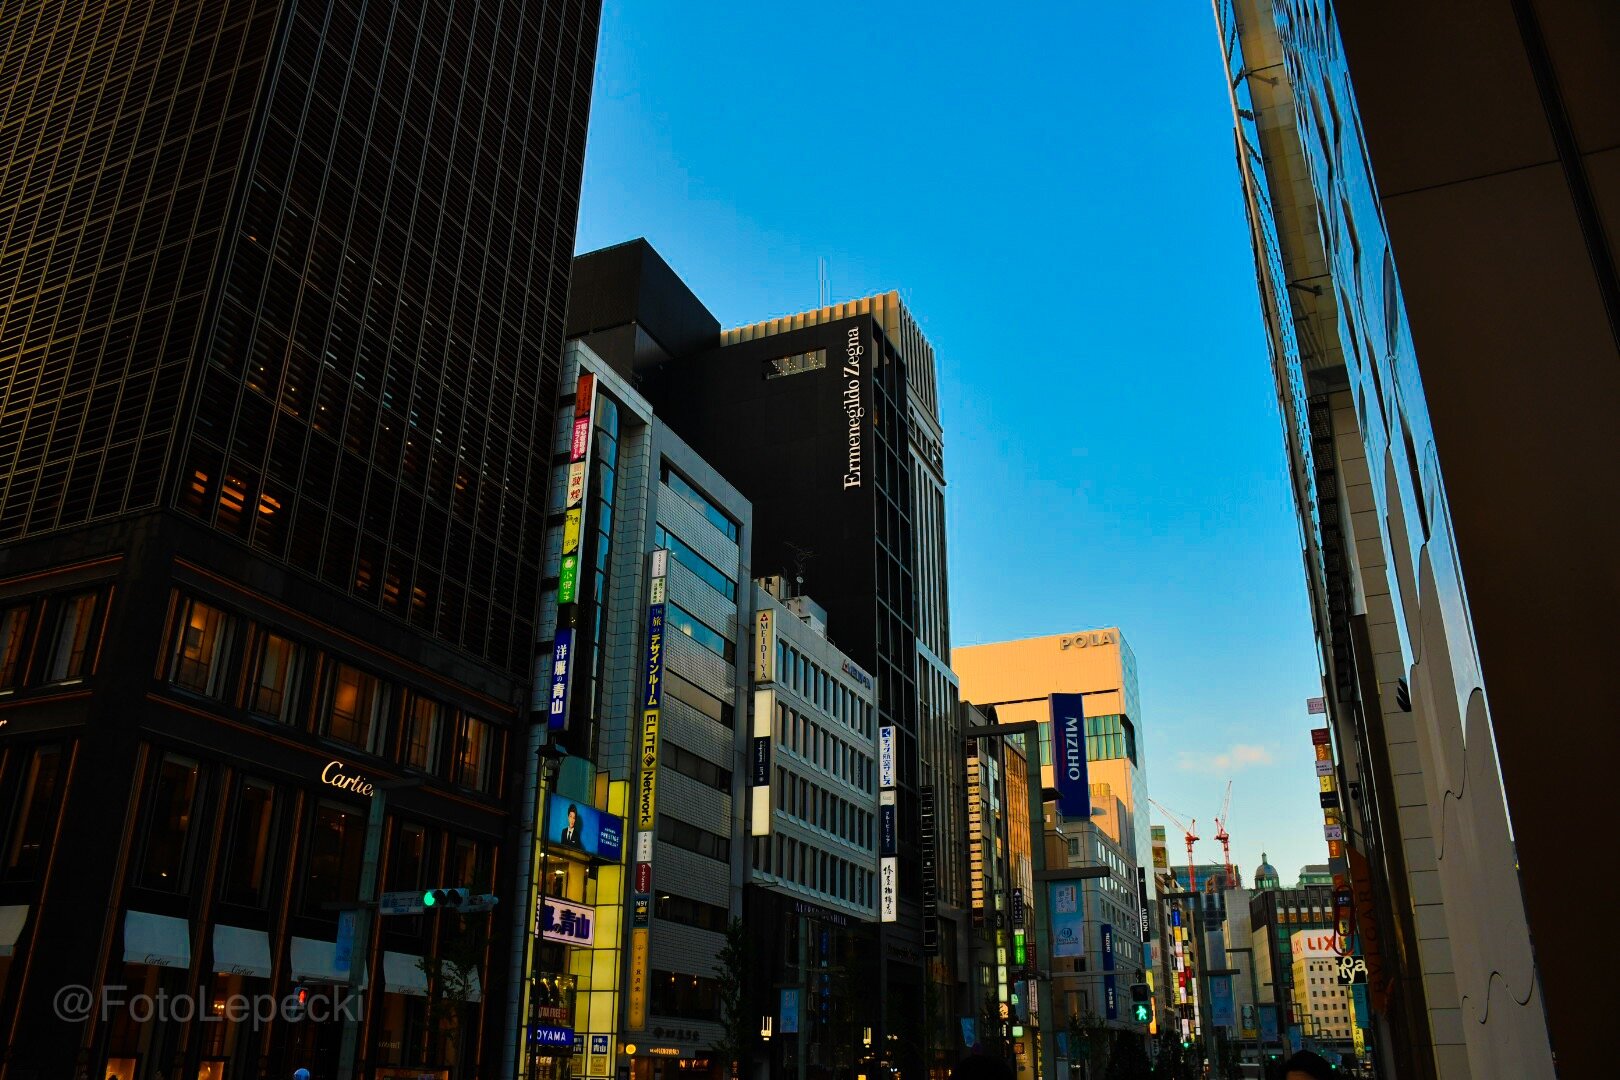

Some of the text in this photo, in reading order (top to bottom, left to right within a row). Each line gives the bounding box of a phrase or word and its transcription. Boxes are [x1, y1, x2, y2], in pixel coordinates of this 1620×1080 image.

[843, 326, 865, 491] Ermenegildo Zegna
[760, 622, 769, 679] MEIDIYA
[1060, 632, 1115, 650] POLA
[551, 644, 568, 715] 洋服の青山
[645, 713, 657, 755] ELITE
[1064, 716, 1081, 781] MIZUHO
[1141, 907, 1149, 932] ALBION
[529, 1030, 567, 1042] OYAMA
